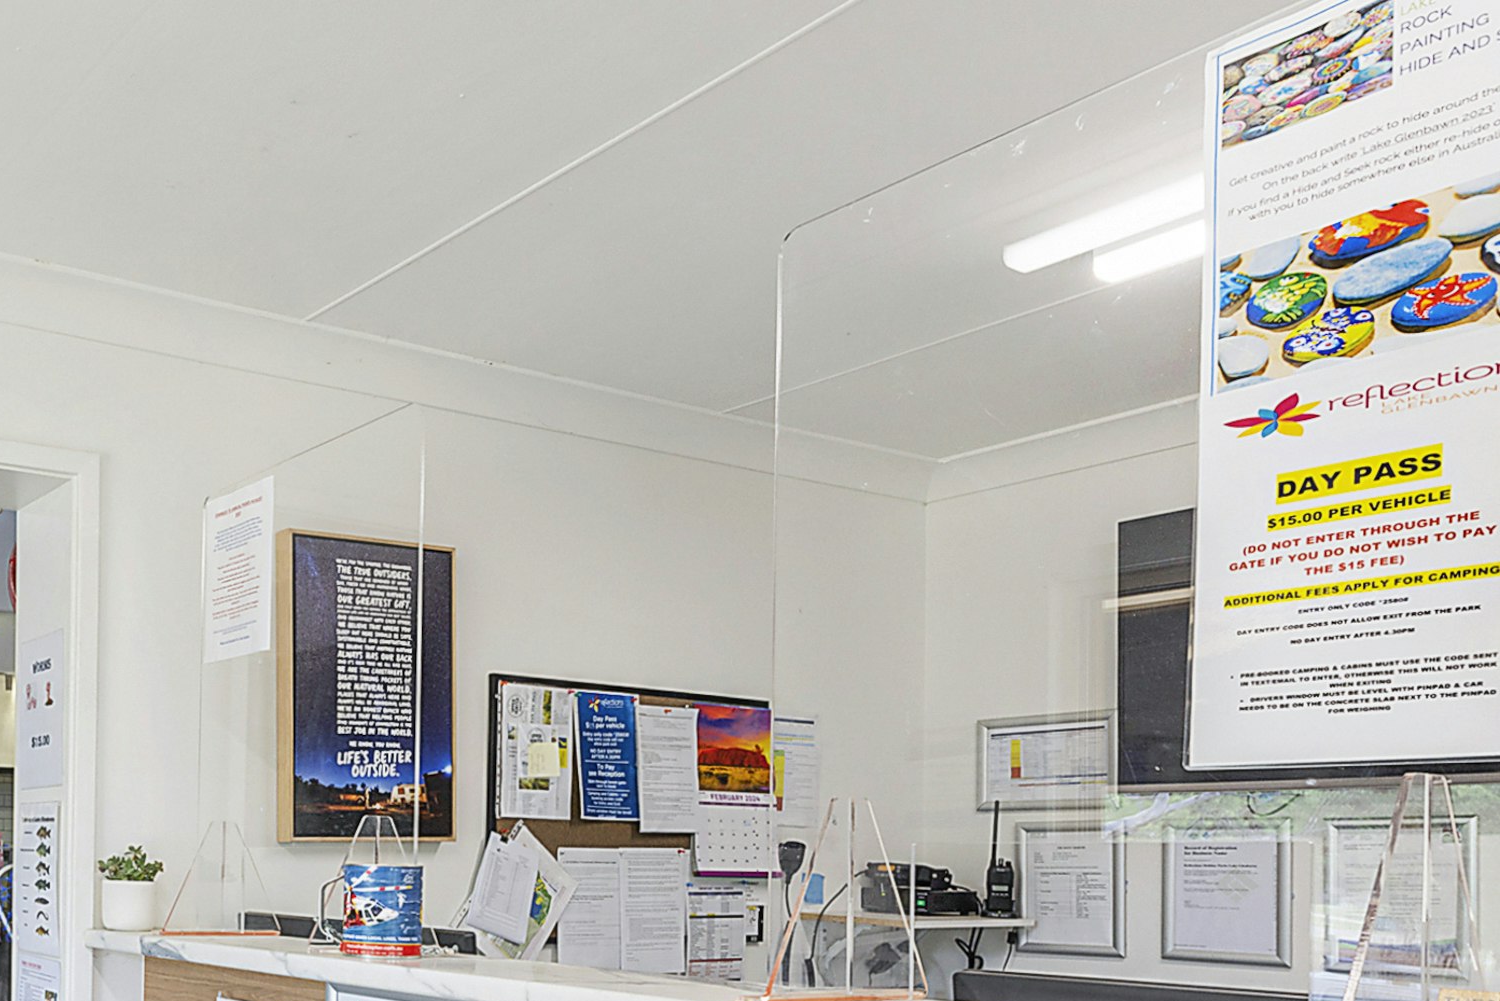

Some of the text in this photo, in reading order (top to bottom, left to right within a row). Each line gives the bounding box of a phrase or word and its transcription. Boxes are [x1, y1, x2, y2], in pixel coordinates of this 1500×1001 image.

[1400, 5, 1452, 33] ROCK
[1400, 13, 1490, 54] PAINTING
[1400, 35, 1491, 75] HIDE AND
[1229, 175, 1248, 188] Get
[1250, 160, 1294, 180] creative
[1297, 150, 1317, 164] and
[1320, 140, 1347, 159] paint
[1358, 125, 1384, 143] rock
[1387, 120, 1399, 130] to
[1402, 109, 1430, 126] hide
[1433, 96, 1479, 115] around
[1262, 180, 1279, 191] On
[1281, 171, 1299, 185] the
[1301, 163, 1328, 178] back
[1331, 149, 1358, 167] write
[1394, 117, 1459, 144] Glenbawn
[1278, 453, 1442, 498] DAY PASS
[1268, 490, 1451, 528] $15.00 PER VEHICLE
[1229, 525, 1497, 572] GATE IF YOU DO NOT WISH TO PAY
[1243, 511, 1480, 556] (DO NOT ENTER THROUGH THE
[337, 565, 351, 575] THE
[1305, 555, 1405, 575] THE $15 FEE)
[337, 594, 353, 604] OUR
[355, 596, 392, 607] GREATEST
[1225, 566, 1500, 607] ADDITIONAL FEES APPLY FOR CAMPING
[1255, 626, 1280, 634] ENTRY
[1283, 623, 1304, 631] CODE
[1351, 615, 1380, 624] ALLOW
[1383, 612, 1402, 620] EXIT
[1406, 610, 1430, 618] FROM
[1434, 607, 1452, 615] THE
[1455, 605, 1481, 613] PARK
[1323, 633, 1351, 641] ENTRY
[337, 750, 412, 765] LIFE'S BETTER
[351, 764, 400, 778] OUTSIDE.
[710, 793, 743, 803] FEBRUARY
